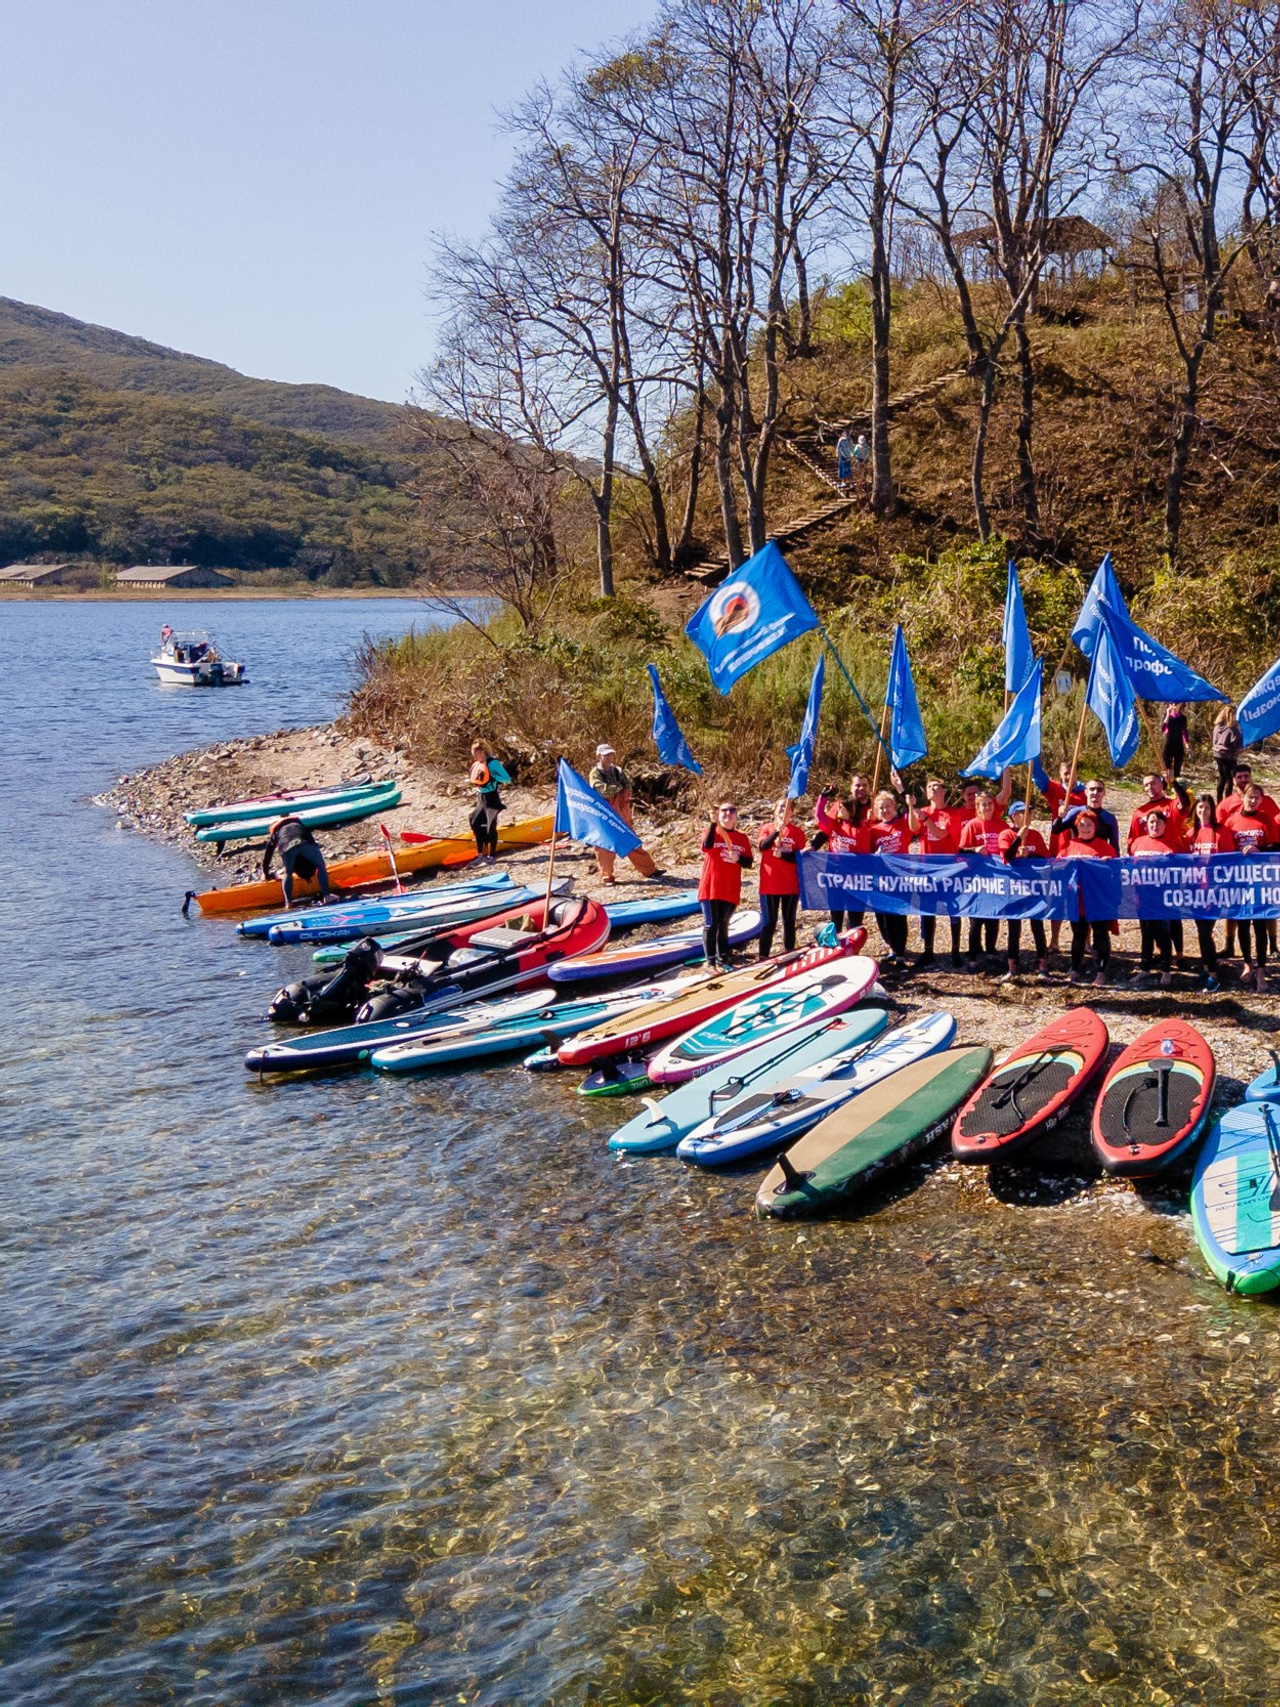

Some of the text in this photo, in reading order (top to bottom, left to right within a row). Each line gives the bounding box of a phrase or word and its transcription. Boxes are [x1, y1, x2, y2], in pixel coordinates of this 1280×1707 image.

[816, 872, 1063, 897] СТРАНЕ НУЖНЫ РАБОЧИЕ МЕСТА!
[1120, 867, 1207, 887] ЗАЩИТИМ
[1163, 887, 1255, 908] СОЗДАДИМ
